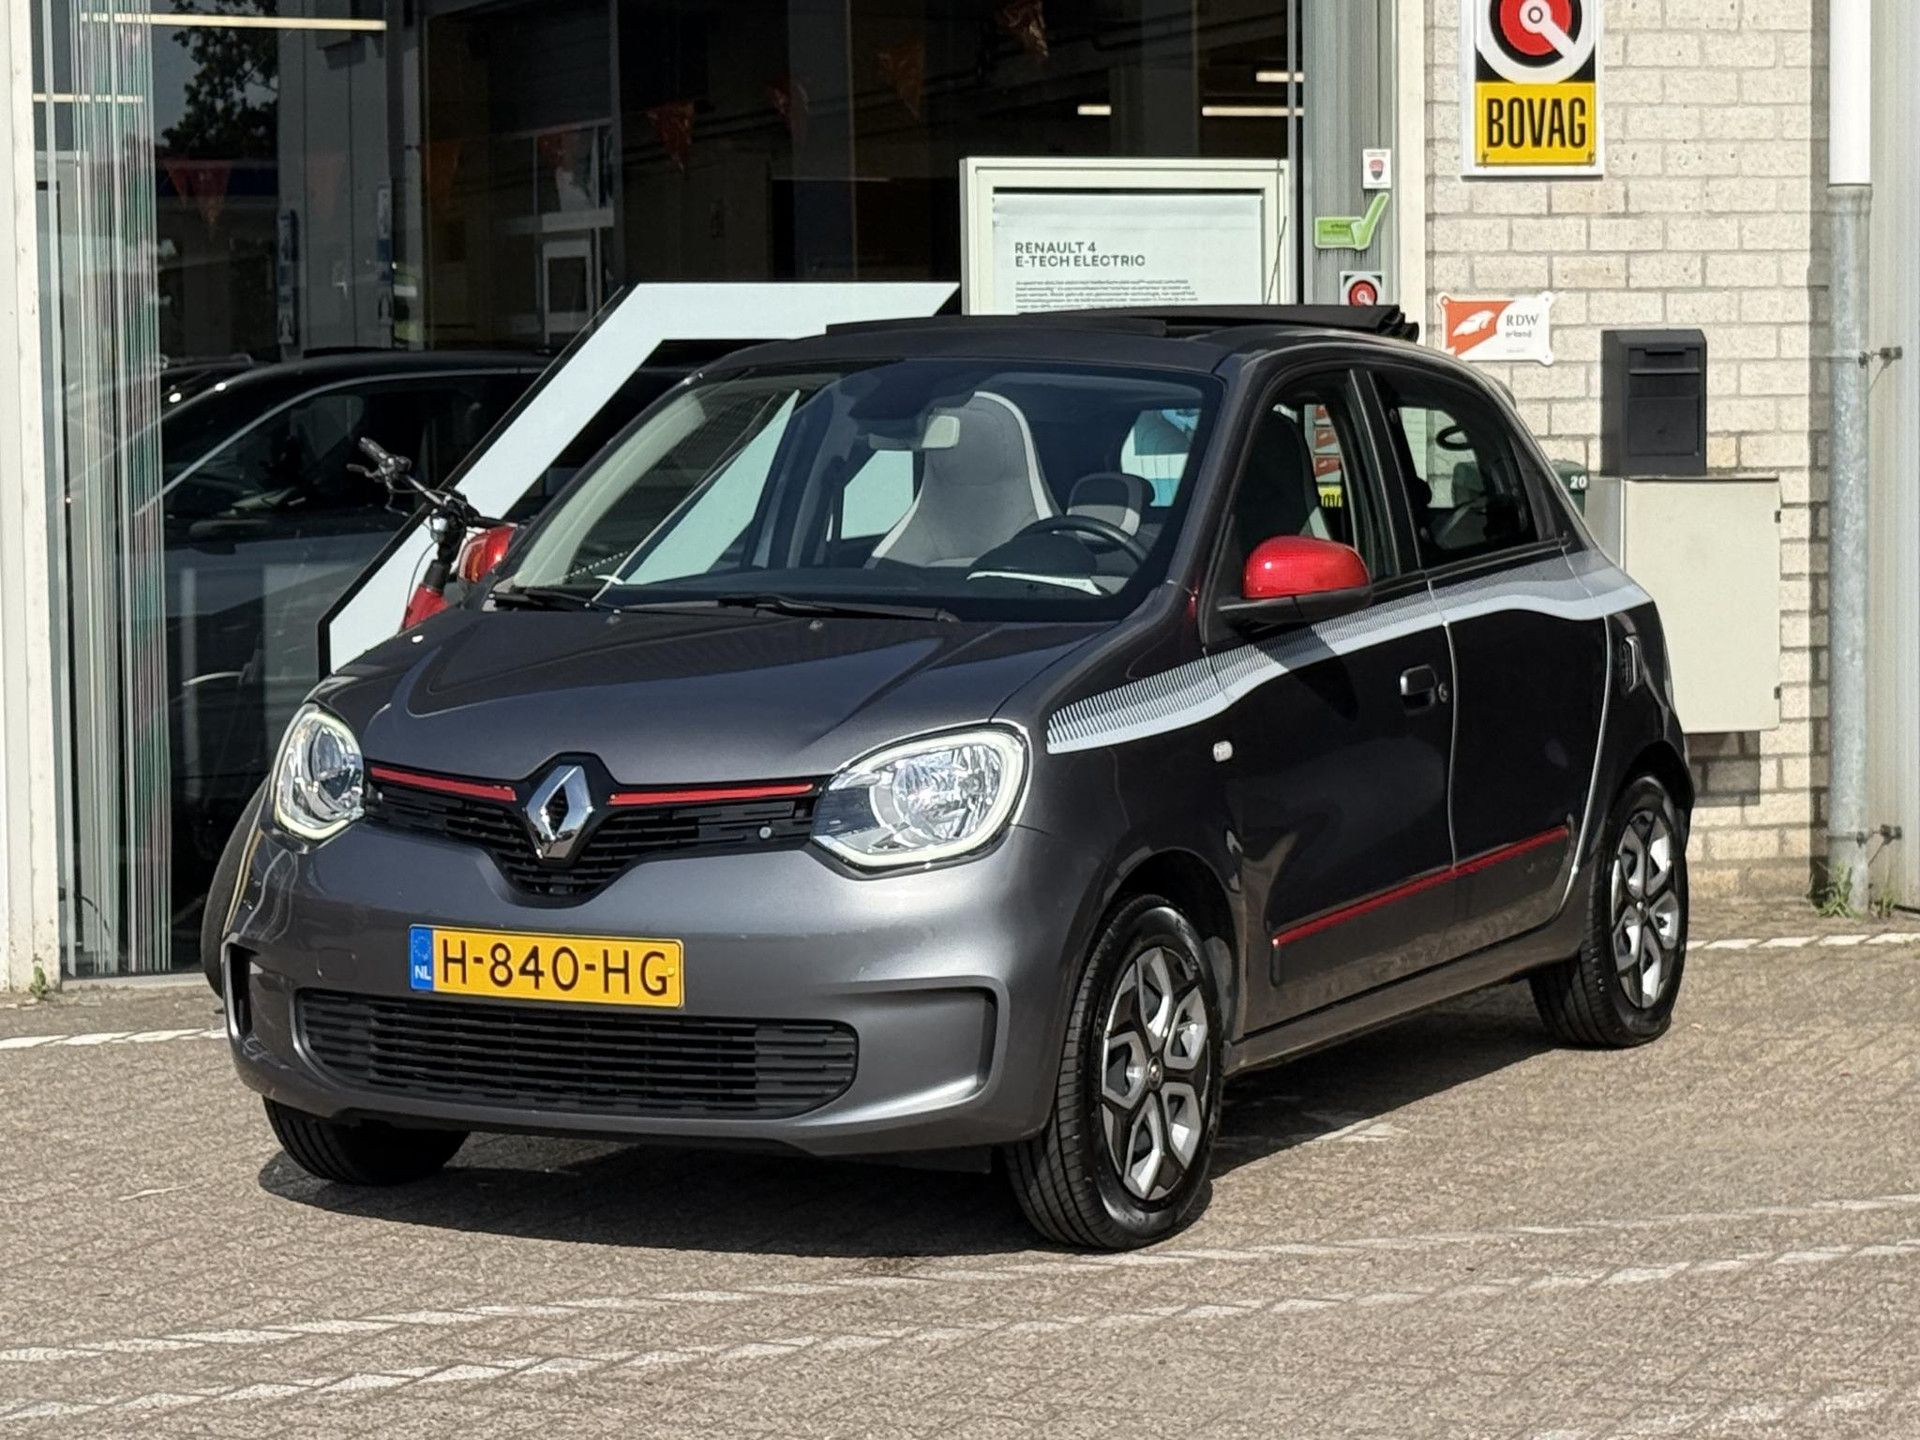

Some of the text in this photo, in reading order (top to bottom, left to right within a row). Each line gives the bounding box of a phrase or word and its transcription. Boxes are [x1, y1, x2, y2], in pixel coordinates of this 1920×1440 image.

[1486, 97, 1586, 149] BOVAG
[1014, 241, 1097, 254] RENAULT 4
[1015, 254, 1146, 267] E-TECH ELECTRIC
[1506, 313, 1539, 327] RDW
[1570, 475, 1588, 489] 20
[414, 964, 432, 981] NL
[442, 938, 668, 997] H-840-HG
